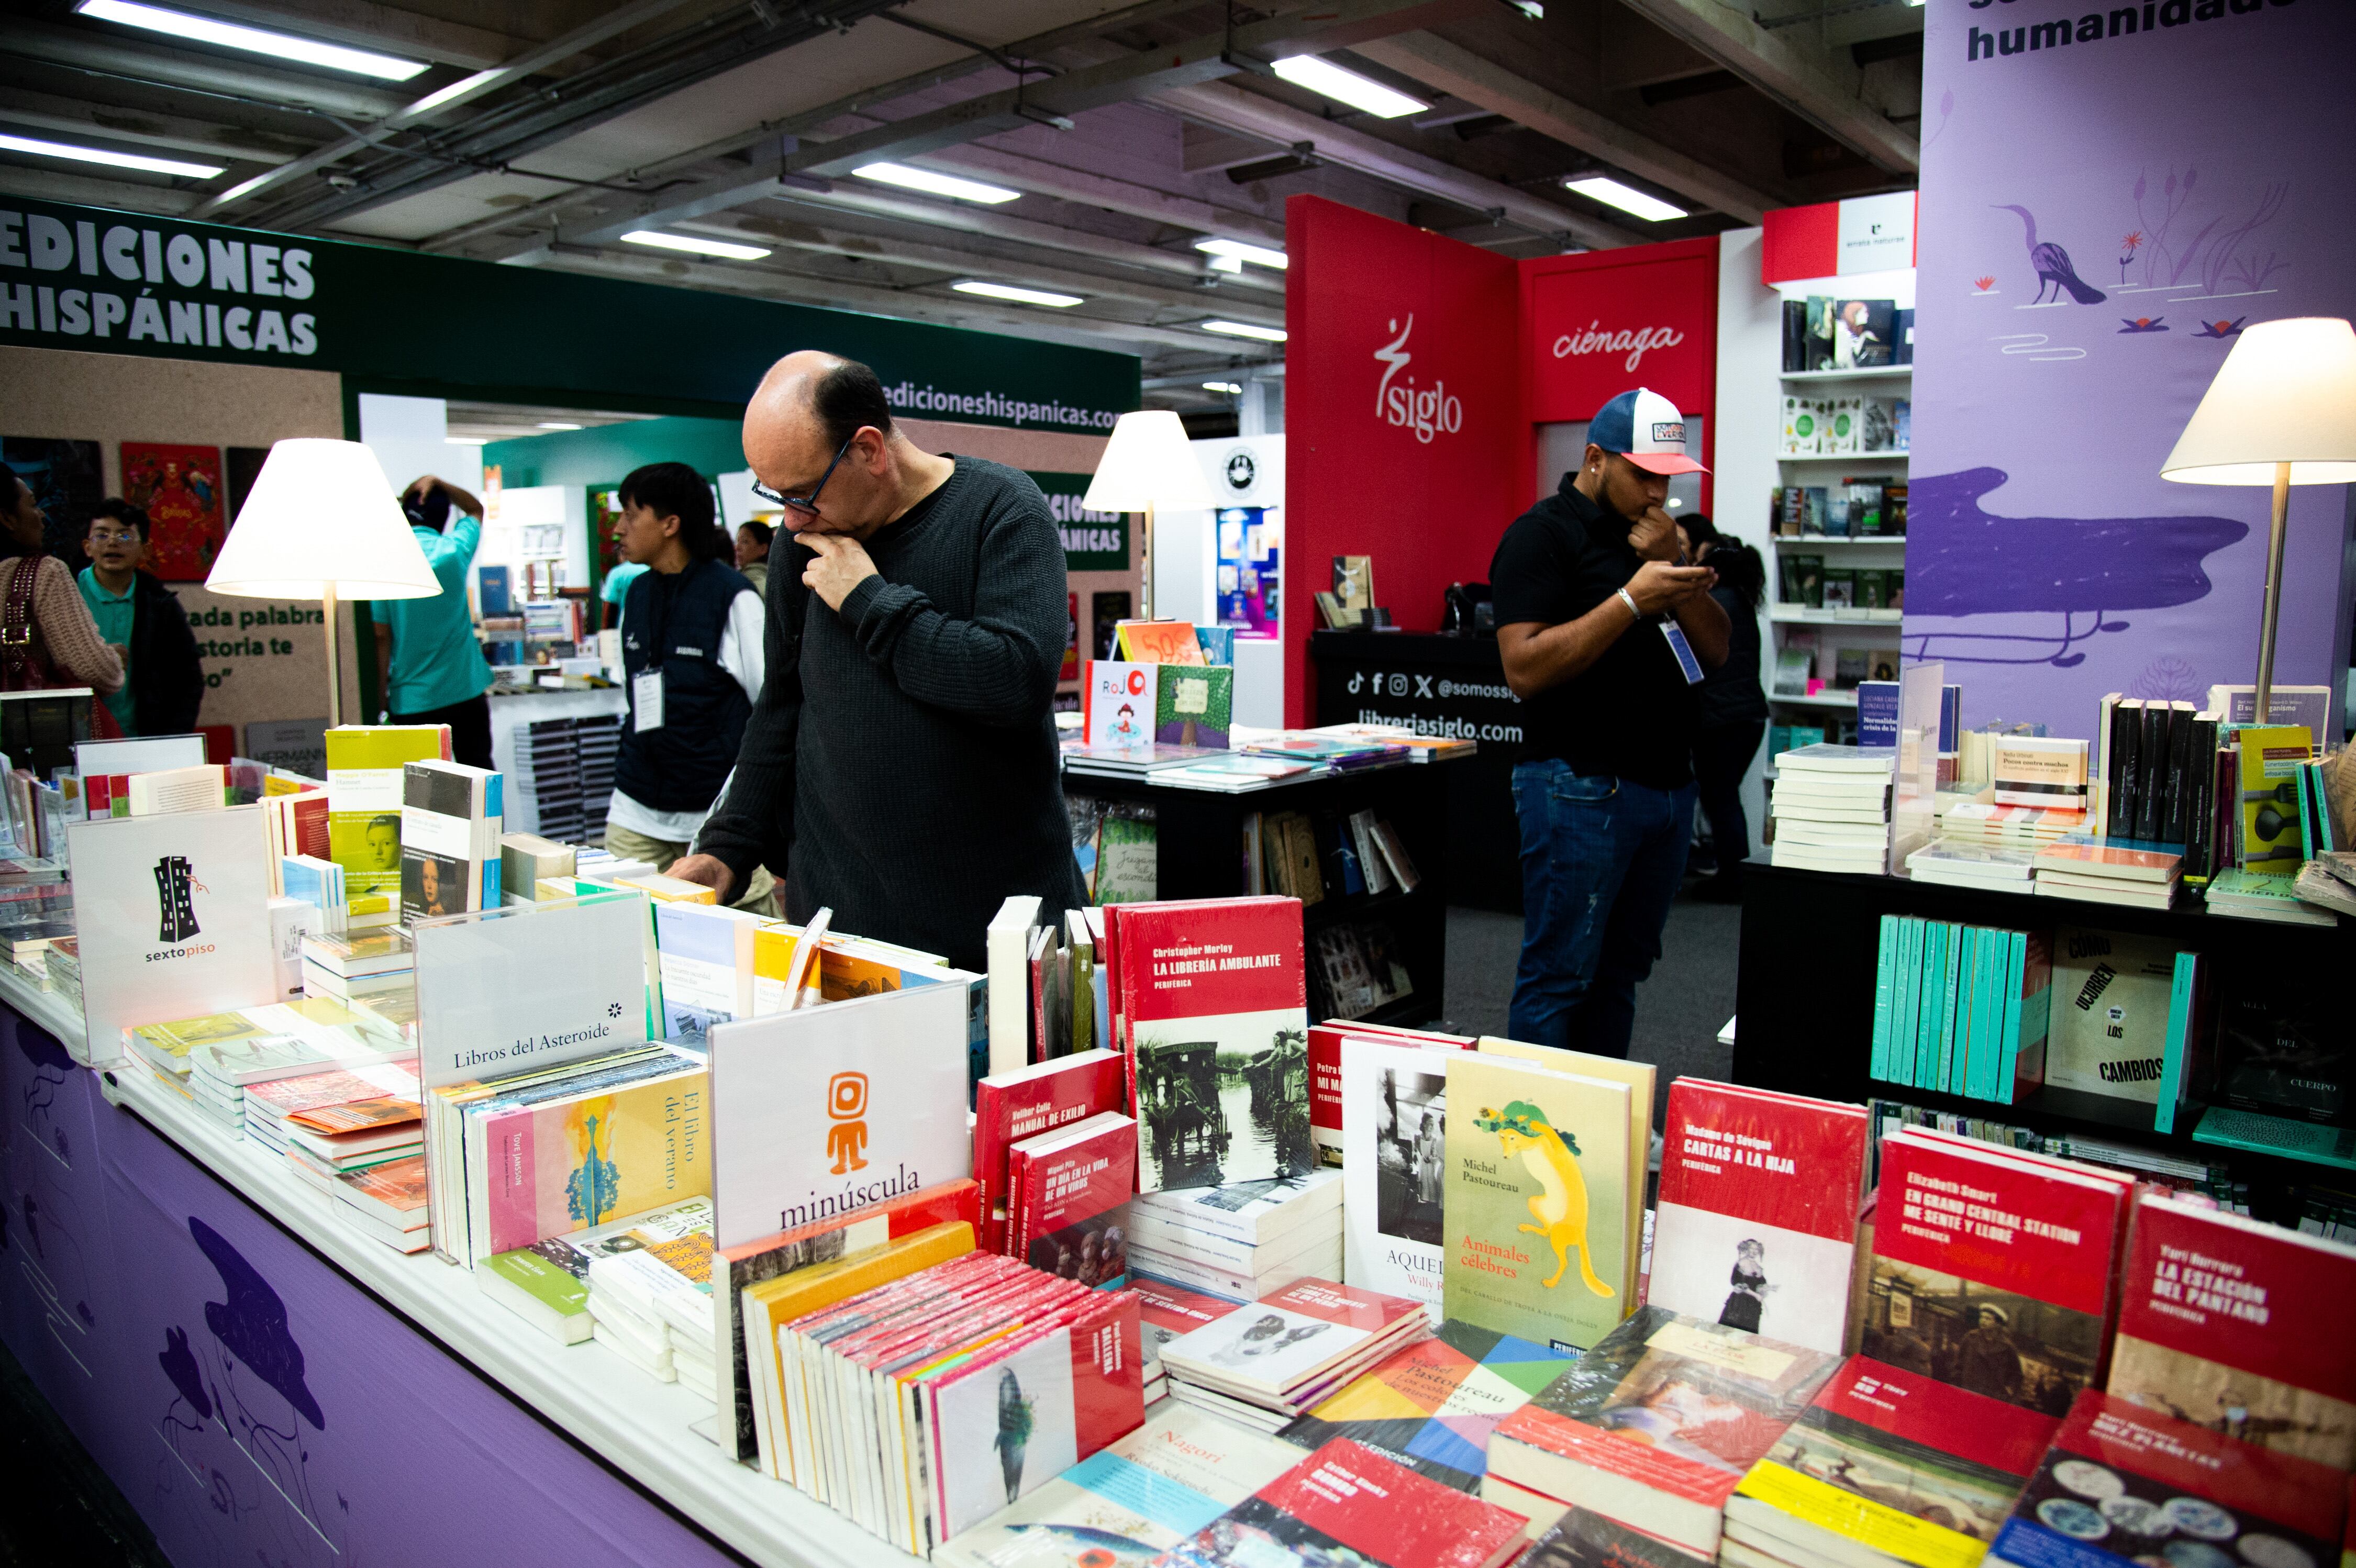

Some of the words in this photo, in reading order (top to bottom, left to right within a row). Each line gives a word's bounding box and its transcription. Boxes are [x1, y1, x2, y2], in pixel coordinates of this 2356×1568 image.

[1847, 239, 1870, 249] errata
[1872, 234, 1905, 246] naturae
[0, 211, 315, 300] EDICIONES
[0, 281, 318, 355] HISPÁNICAS
[1553, 319, 1684, 373] ciénaga
[1387, 375, 1463, 443] siglo
[186, 605, 233, 627] ada
[239, 604, 324, 630] palabra
[269, 636, 293, 655] te
[146, 943, 215, 962] sextopiso
[1153, 946, 1203, 959] Christopher
[1204, 944, 1233, 956] Morley
[1153, 961, 1168, 977] LA
[1169, 958, 1218, 975] LIBRERÍA
[1219, 954, 1281, 973] AMBULANTE
[1154, 977, 1192, 991] PERIFÉRICA
[2107, 1025, 2124, 1039] LOS
[2276, 1037, 2298, 1049] DEL
[453, 1048, 506, 1070] Libros
[512, 1037, 535, 1056] del
[539, 1023, 610, 1051] Asteroide
[1317, 1062, 1337, 1074] Petra
[2099, 1058, 2163, 1083] CAMBIOS
[2290, 1078, 2337, 1093] CUERPO
[664, 1096, 681, 1127] del
[683, 1091, 699, 1116] El
[1012, 1105, 1035, 1121] Velibor
[1011, 1116, 1047, 1137] MANUAL
[1048, 1113, 1059, 1127] DE
[1060, 1104, 1086, 1122] EXILIO
[513, 1132, 522, 1152] TOVE
[683, 1121, 699, 1163] libro
[1685, 1124, 1721, 1142] Madame
[1722, 1132, 1735, 1144] de
[665, 1132, 677, 1191] verano
[1321, 1151, 1329, 1160] 16
[1462, 1158, 1497, 1175] Michel
[1683, 1139, 1730, 1162] CARTAS
[1733, 1149, 1743, 1163] A
[1746, 1152, 1762, 1168] LA
[1765, 1155, 1795, 1175] HIJA
[512, 1153, 523, 1186] JANSSON
[1046, 1177, 1058, 1190] UN
[1058, 1173, 1071, 1186] DÍA
[1072, 1168, 1082, 1181] EN
[1082, 1164, 1092, 1176] LA
[1092, 1157, 1109, 1173] VIDA
[1462, 1171, 1519, 1193] Pastoureau
[780, 1162, 921, 1231] minúscula
[1044, 1190, 1055, 1202] DE
[1055, 1186, 1067, 1198] UN
[1067, 1176, 1089, 1195] VIRUS
[1903, 1204, 1923, 1220] ME
[1964, 1219, 1975, 1233] Y
[1905, 1188, 1922, 1204] EN
[1923, 1192, 1965, 1215] GRAND
[1965, 1204, 2021, 1230] CENTRAL
[2023, 1218, 2081, 1247] STATION
[1461, 1235, 1530, 1264] Animales
[1460, 1253, 1517, 1279] célebres
[1407, 1273, 1435, 1292] Willy
[2155, 1260, 2179, 1282] LA
[2182, 1266, 2268, 1305] ESTACIÓN
[1155, 1300, 1190, 1314] SENTIDO
[1459, 1286, 1473, 1294] DEL
[1475, 1290, 1501, 1303] CABALLO
[1514, 1300, 1535, 1311] TROYA
[2152, 1277, 2182, 1300] DEL
[2185, 1286, 2270, 1327] PANTANO
[1102, 1325, 1113, 1375] BALLENA
[1409, 1356, 1454, 1375] Michel
[1384, 1381, 1401, 1391] de
[1403, 1387, 1457, 1409] nuestros
[1396, 1374, 1418, 1386] Los
[1420, 1382, 1467, 1402] colores
[1406, 1366, 1505, 1404] Pastoureau
[1157, 1429, 1227, 1464] Nagori
[1368, 1443, 1418, 1467] EDICIÓN
[1310, 1468, 1360, 1498] ROMBO
